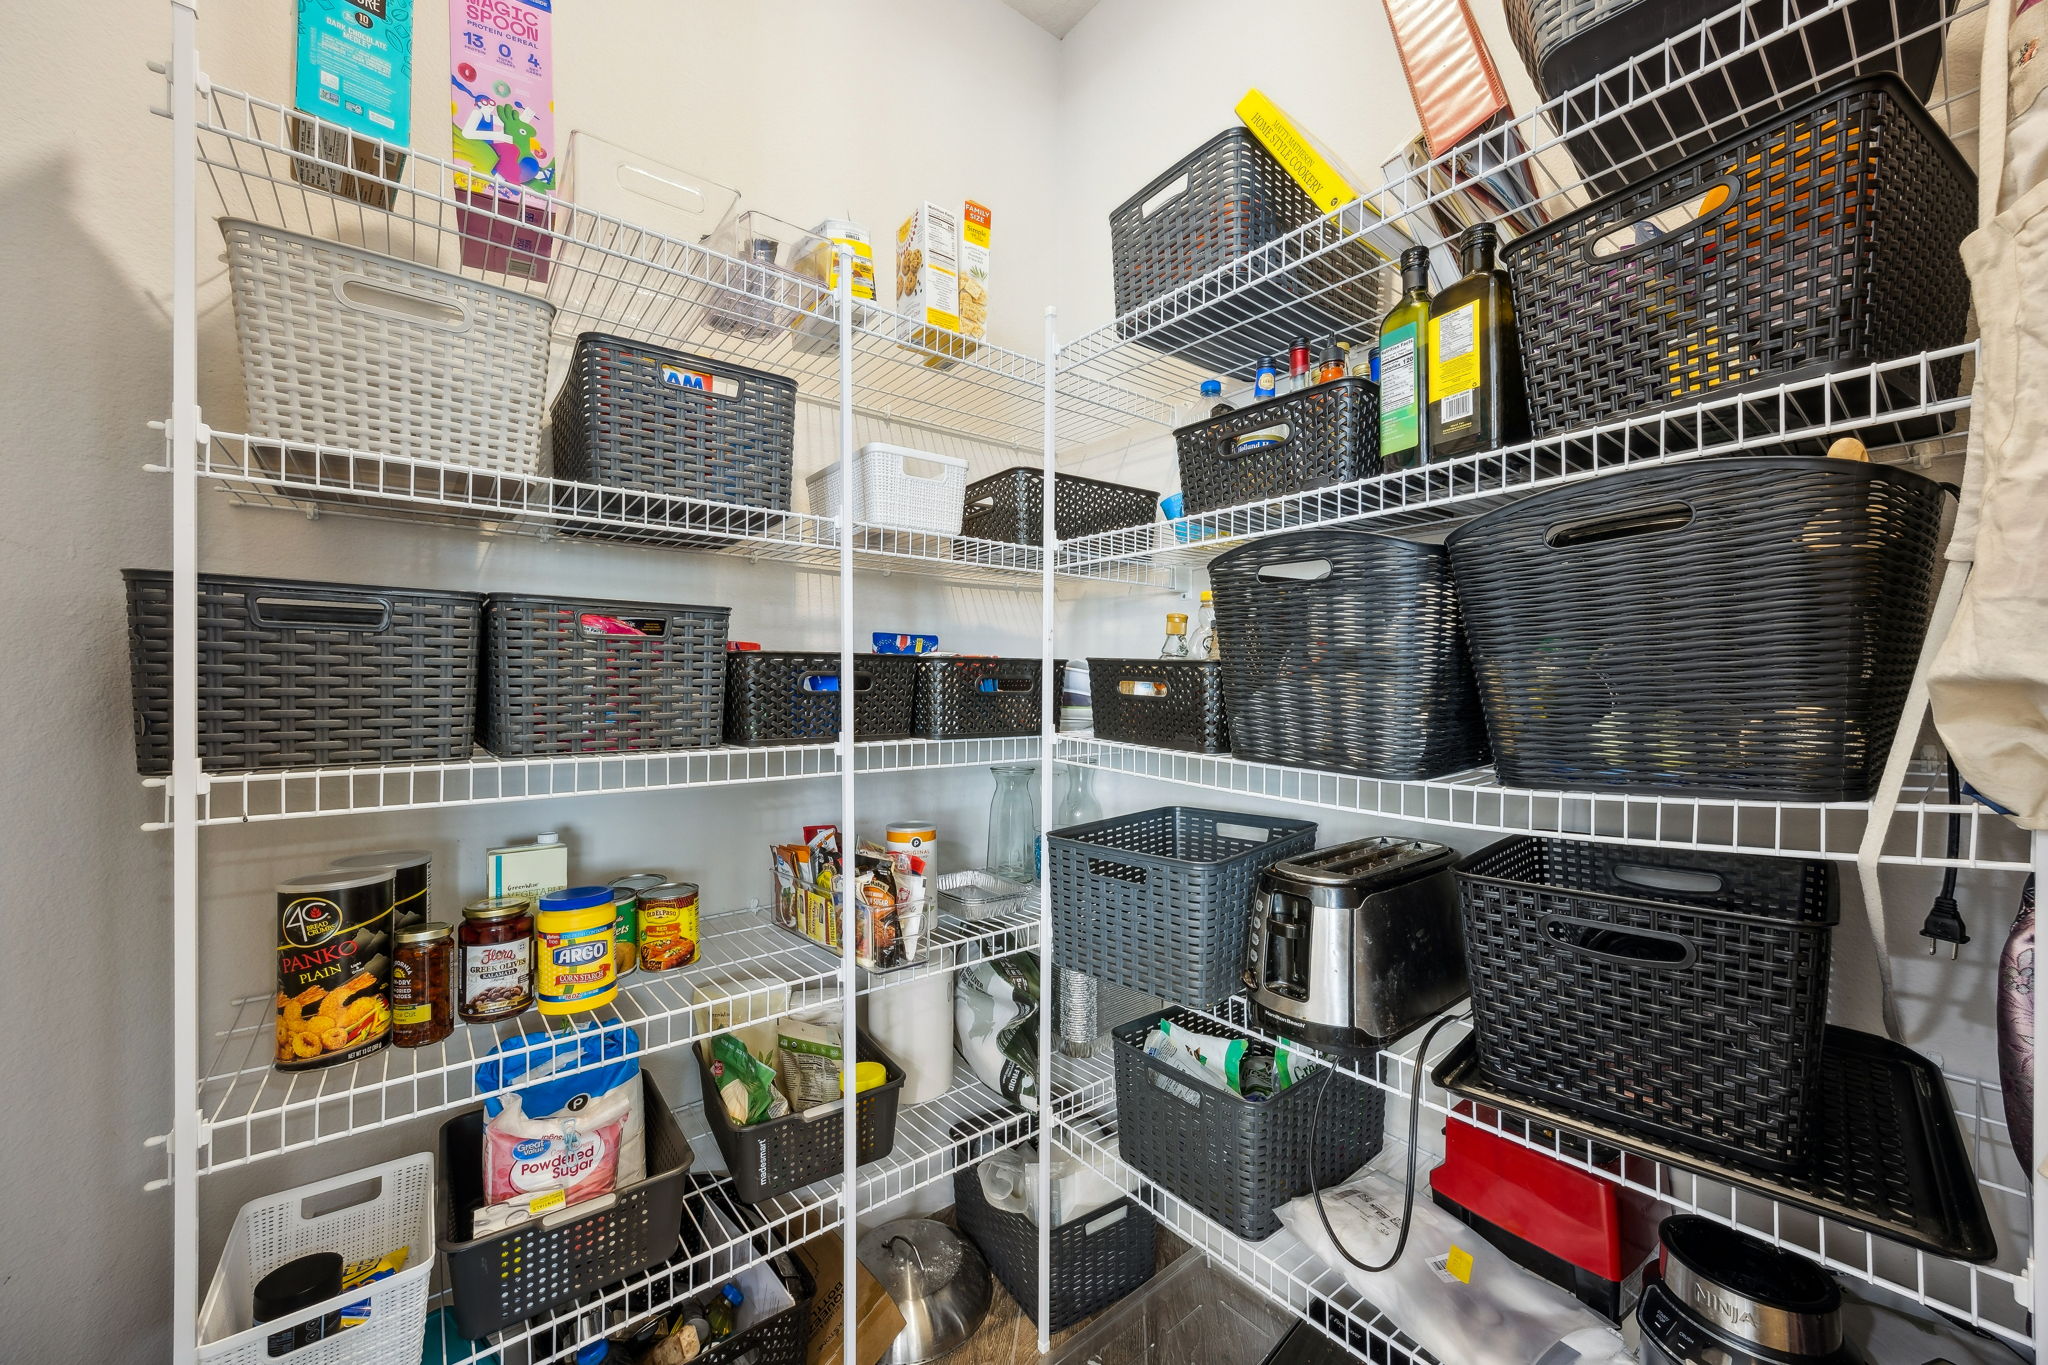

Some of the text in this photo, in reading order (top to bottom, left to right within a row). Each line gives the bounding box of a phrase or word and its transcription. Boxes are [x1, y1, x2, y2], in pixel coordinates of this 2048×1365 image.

[466, 5, 538, 42] SPOON
[326, 17, 387, 50] DARK CHOCOLATE
[343, 31, 372, 49] MEDLEY
[467, 20, 539, 50] PROTEIN CEREAL
[1250, 112, 1324, 195] HOME STYLE COOKERY
[1288, 136, 1316, 168] MATHESON
[965, 203, 990, 219] FAMILY
[969, 212, 985, 224] SIZE
[1381, 356, 1414, 374] Calories 120
[662, 909, 677, 917] PASO
[305, 920, 329, 932] BREAD
[307, 924, 337, 937] CRUMBS
[282, 940, 358, 974] PANKO
[481, 949, 516, 965] Flora
[558, 943, 603, 964] ARGO
[298, 963, 342, 985] PLAIN
[470, 957, 526, 974] GREEK OLIVES
[482, 968, 515, 979] KALAMATA
[559, 970, 604, 982] CORN STARCH
[1264, 1010, 1304, 1027] Hamilton Beach
[348, 1052, 356, 1060] NET
[517, 1140, 545, 1152] Great
[523, 1146, 545, 1156] Value
[521, 1145, 594, 1176] Powdered
[552, 1158, 594, 1179] Sugar
[758, 1139, 767, 1186] madesmart
[1695, 1282, 1758, 1329] NINJA
